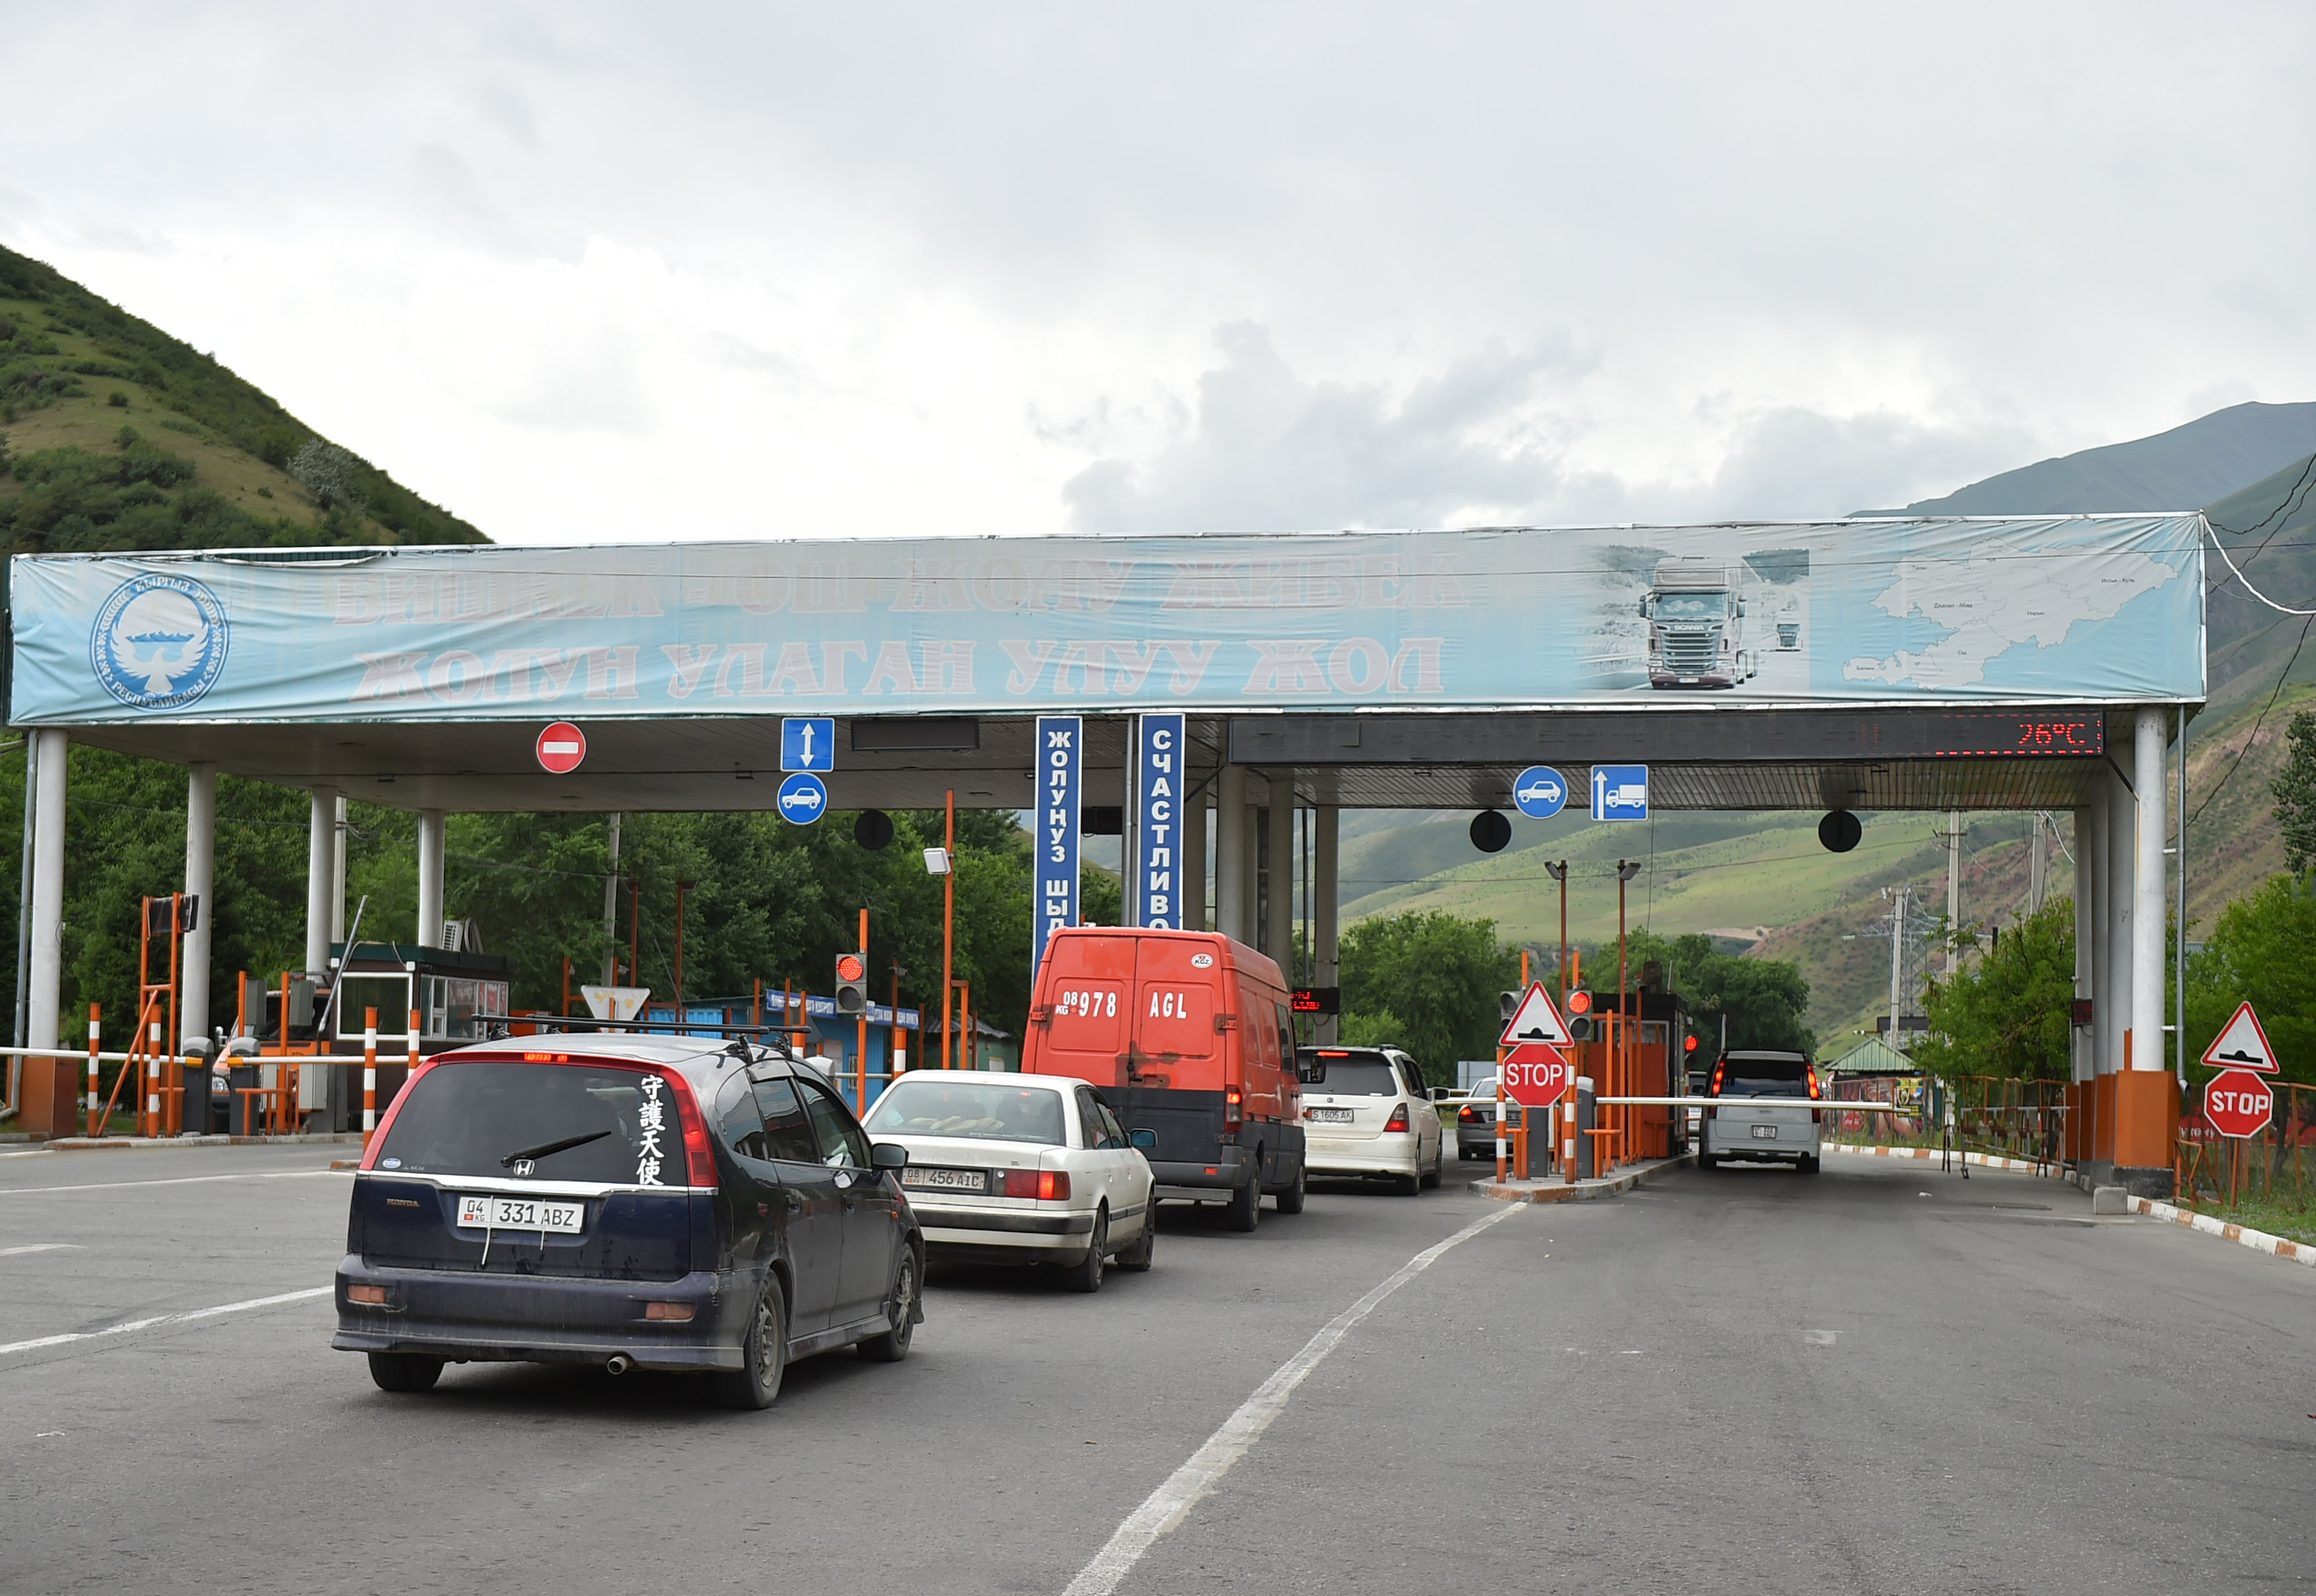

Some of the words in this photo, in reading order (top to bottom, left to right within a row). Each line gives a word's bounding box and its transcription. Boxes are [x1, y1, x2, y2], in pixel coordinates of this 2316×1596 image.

[135, 576, 191, 592] КЫРГЫЗ
[1161, 553, 1470, 610] ЖИБЕК
[349, 645, 641, 703] ЖОЛУН
[661, 639, 977, 699] УЛАГАН
[998, 639, 1221, 695] УЛУУ
[1241, 637, 1444, 695] ЖОЛ
[1048, 731, 1072, 863] ЖОЛУҢУЗ
[1056, 1004, 1068, 1015] KG
[1063, 991, 1078, 1006] 08
[1079, 992, 1116, 1017] 978
[1149, 992, 1187, 1019] AGL
[1506, 1062, 1563, 1086] STOP
[1321, 1111, 1339, 1119] 1605
[2211, 1091, 2269, 1115] STOP
[636, 1075, 666, 1186] 守護天使
[929, 1171, 954, 1185] 456
[387, 1199, 420, 1207] HONDA
[467, 1200, 484, 1213] 04
[499, 1203, 536, 1223] 331
[540, 1209, 575, 1226] ABZ
